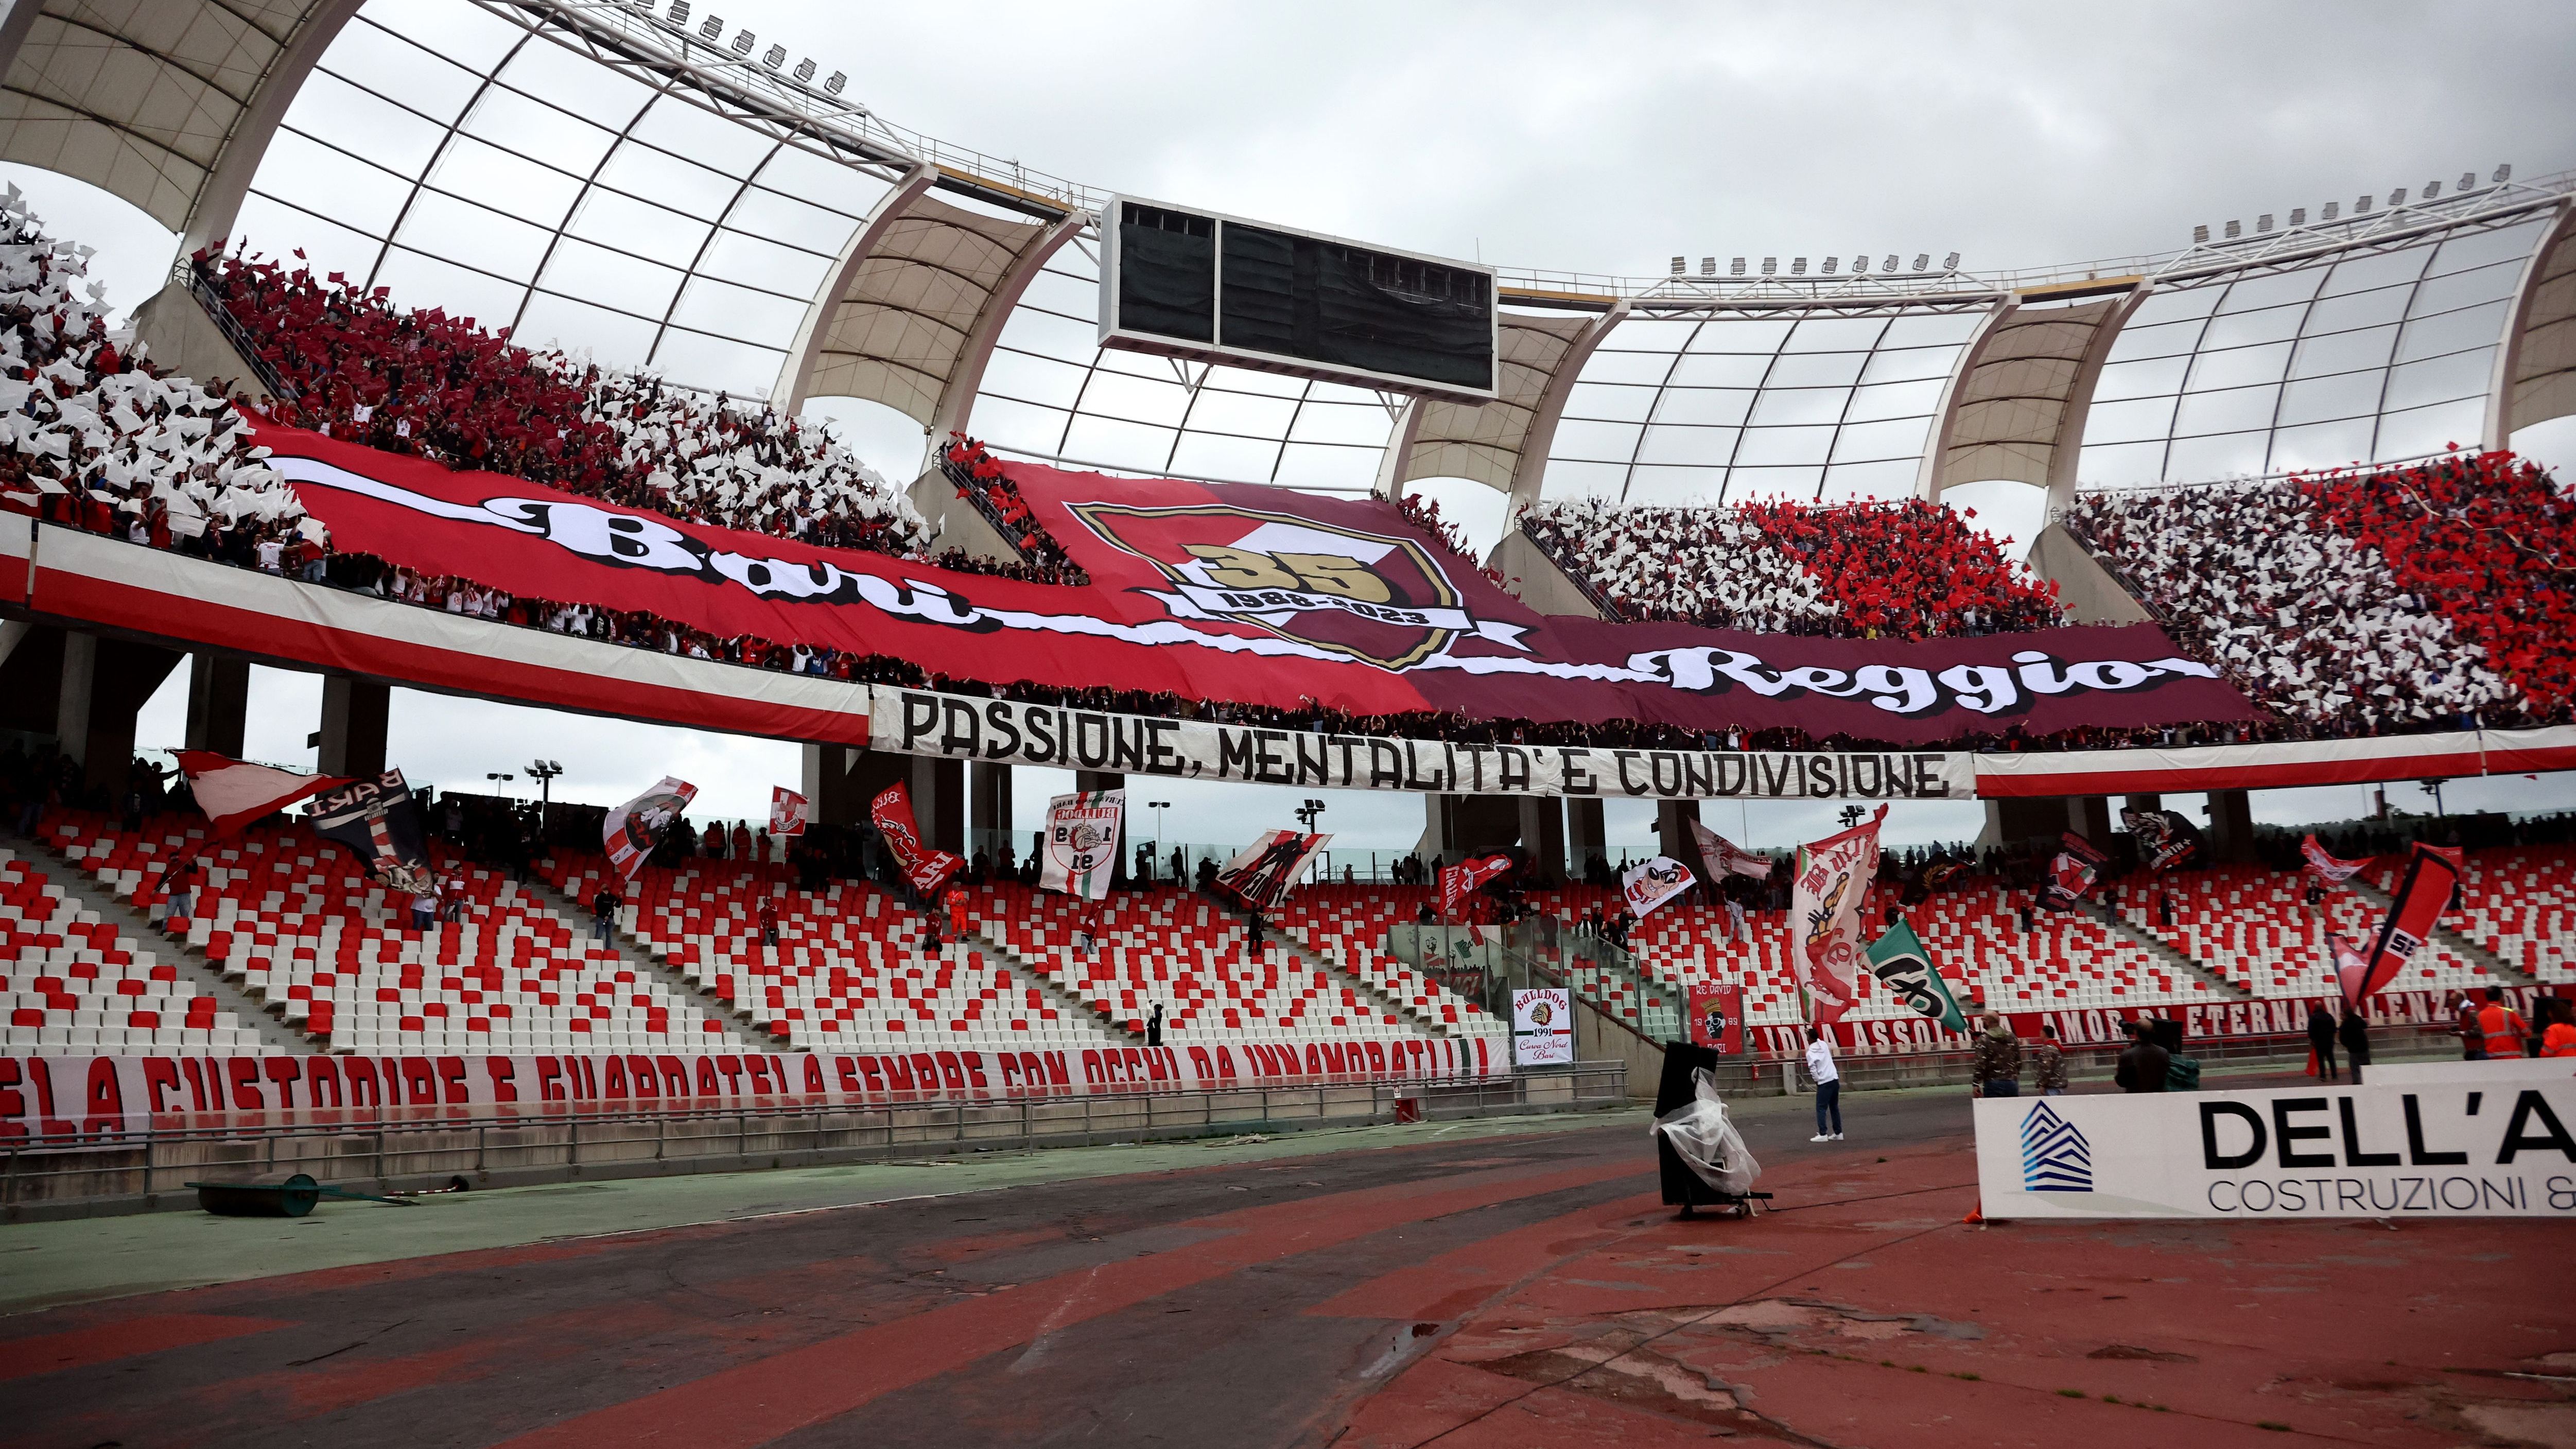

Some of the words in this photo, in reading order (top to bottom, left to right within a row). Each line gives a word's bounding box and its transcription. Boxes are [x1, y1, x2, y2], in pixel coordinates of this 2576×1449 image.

[483, 497, 981, 624] Bari
[1181, 544, 1392, 603] 35
[1219, 588, 1430, 625] 1988-2023
[1627, 646, 2149, 713] Reggio
[901, 692, 1201, 778] PASSIONE,
[1220, 728, 1545, 791] MENTALITA'
[1560, 749, 1597, 795] E
[1613, 750, 1950, 799] CONDIVISIONE
[1515, 989, 1567, 1012] BULLDOG
[1696, 985, 1707, 995] RE
[1710, 985, 1731, 994] DAVID
[1534, 1028, 1552, 1037] 1991
[2186, 999, 2308, 1037] ETERNA
[1520, 1039, 1541, 1050] Curva
[1543, 1039, 1568, 1049] Nord
[1533, 1049, 1555, 1060] Bari
[486, 1056, 519, 1129] E
[535, 1054, 828, 1123] GUARDATELA
[835, 1051, 991, 1111] SEMPRE
[997, 1051, 1073, 1105] CON
[1082, 1046, 1182, 1097] OCCHI
[1188, 1045, 1238, 1094] DA
[2199, 1090, 2576, 1169] DELL'A
[2207, 1176, 2528, 1212] COSTRUZIONI
